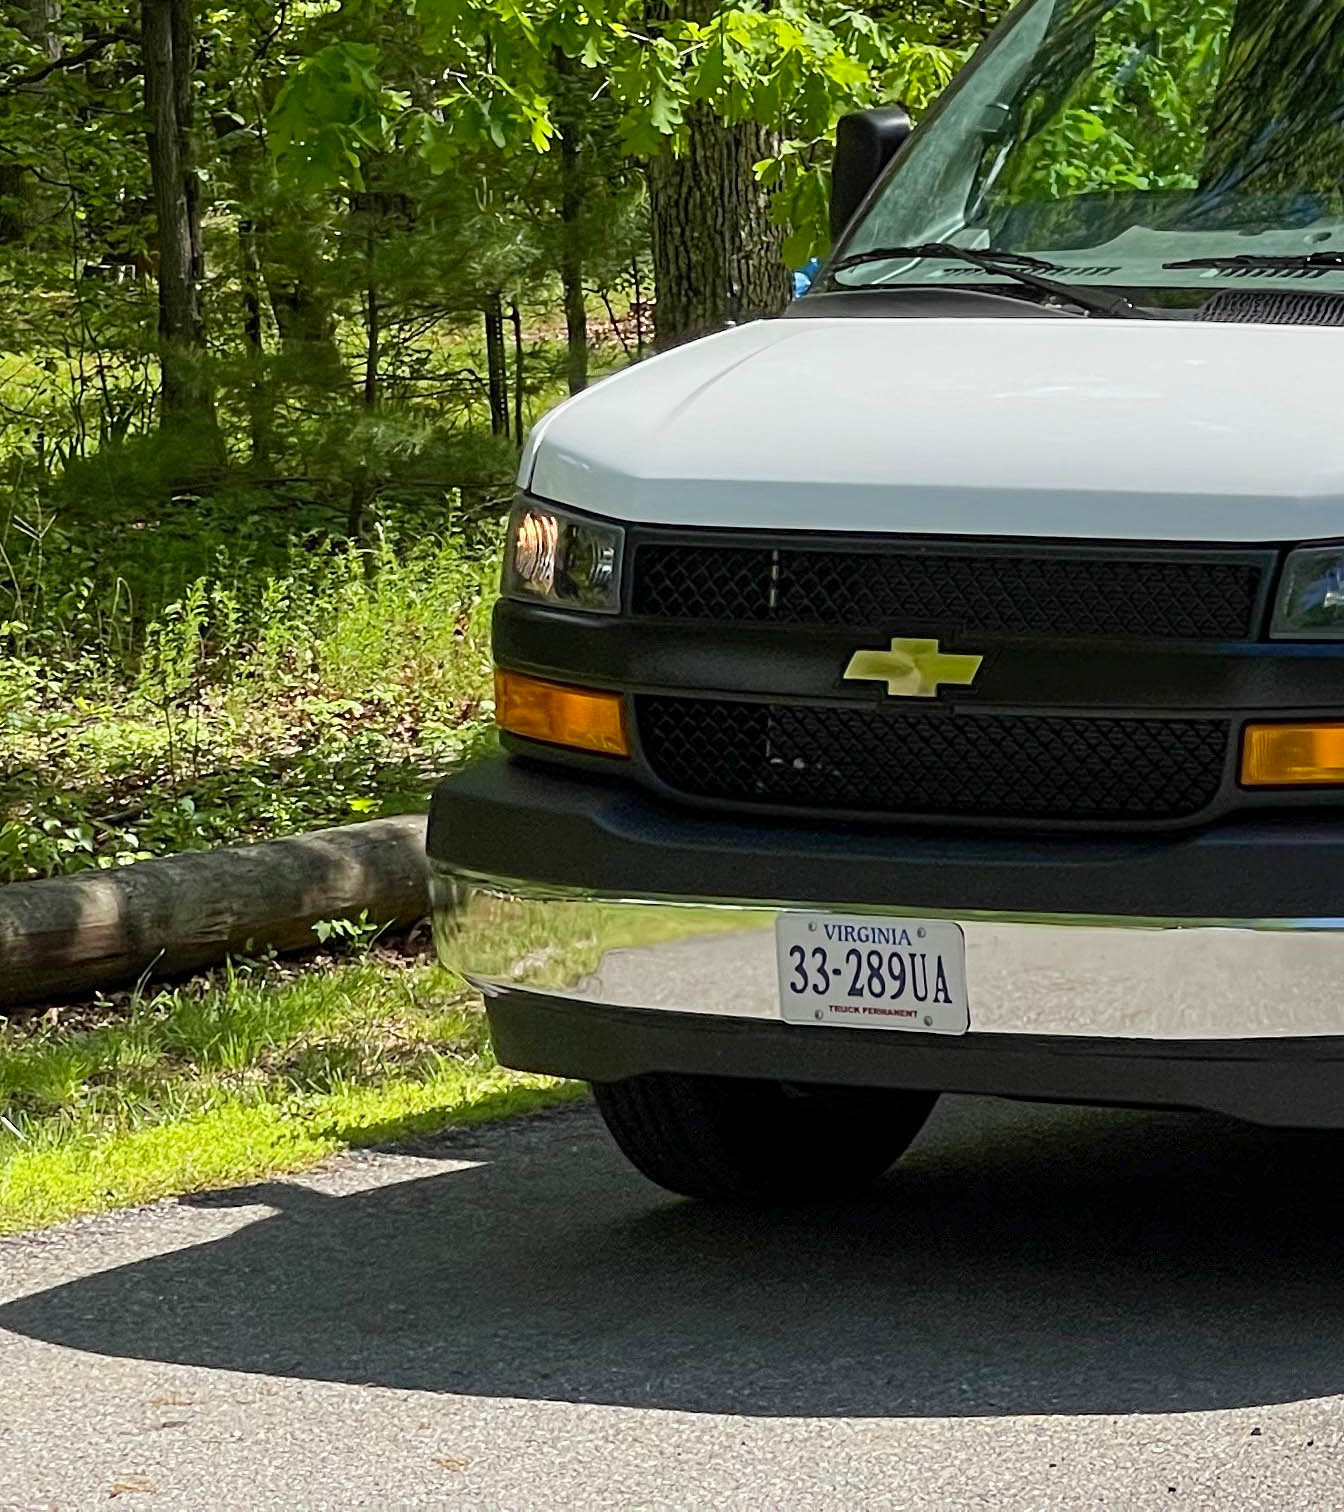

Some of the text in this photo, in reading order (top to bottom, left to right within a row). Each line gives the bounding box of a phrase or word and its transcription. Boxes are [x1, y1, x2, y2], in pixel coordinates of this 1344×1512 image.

[823, 923, 912, 946] VIRGINIA
[789, 944, 953, 1004] 33-289UA
[828, 1004, 917, 1018] TRUCK PERMANENT
